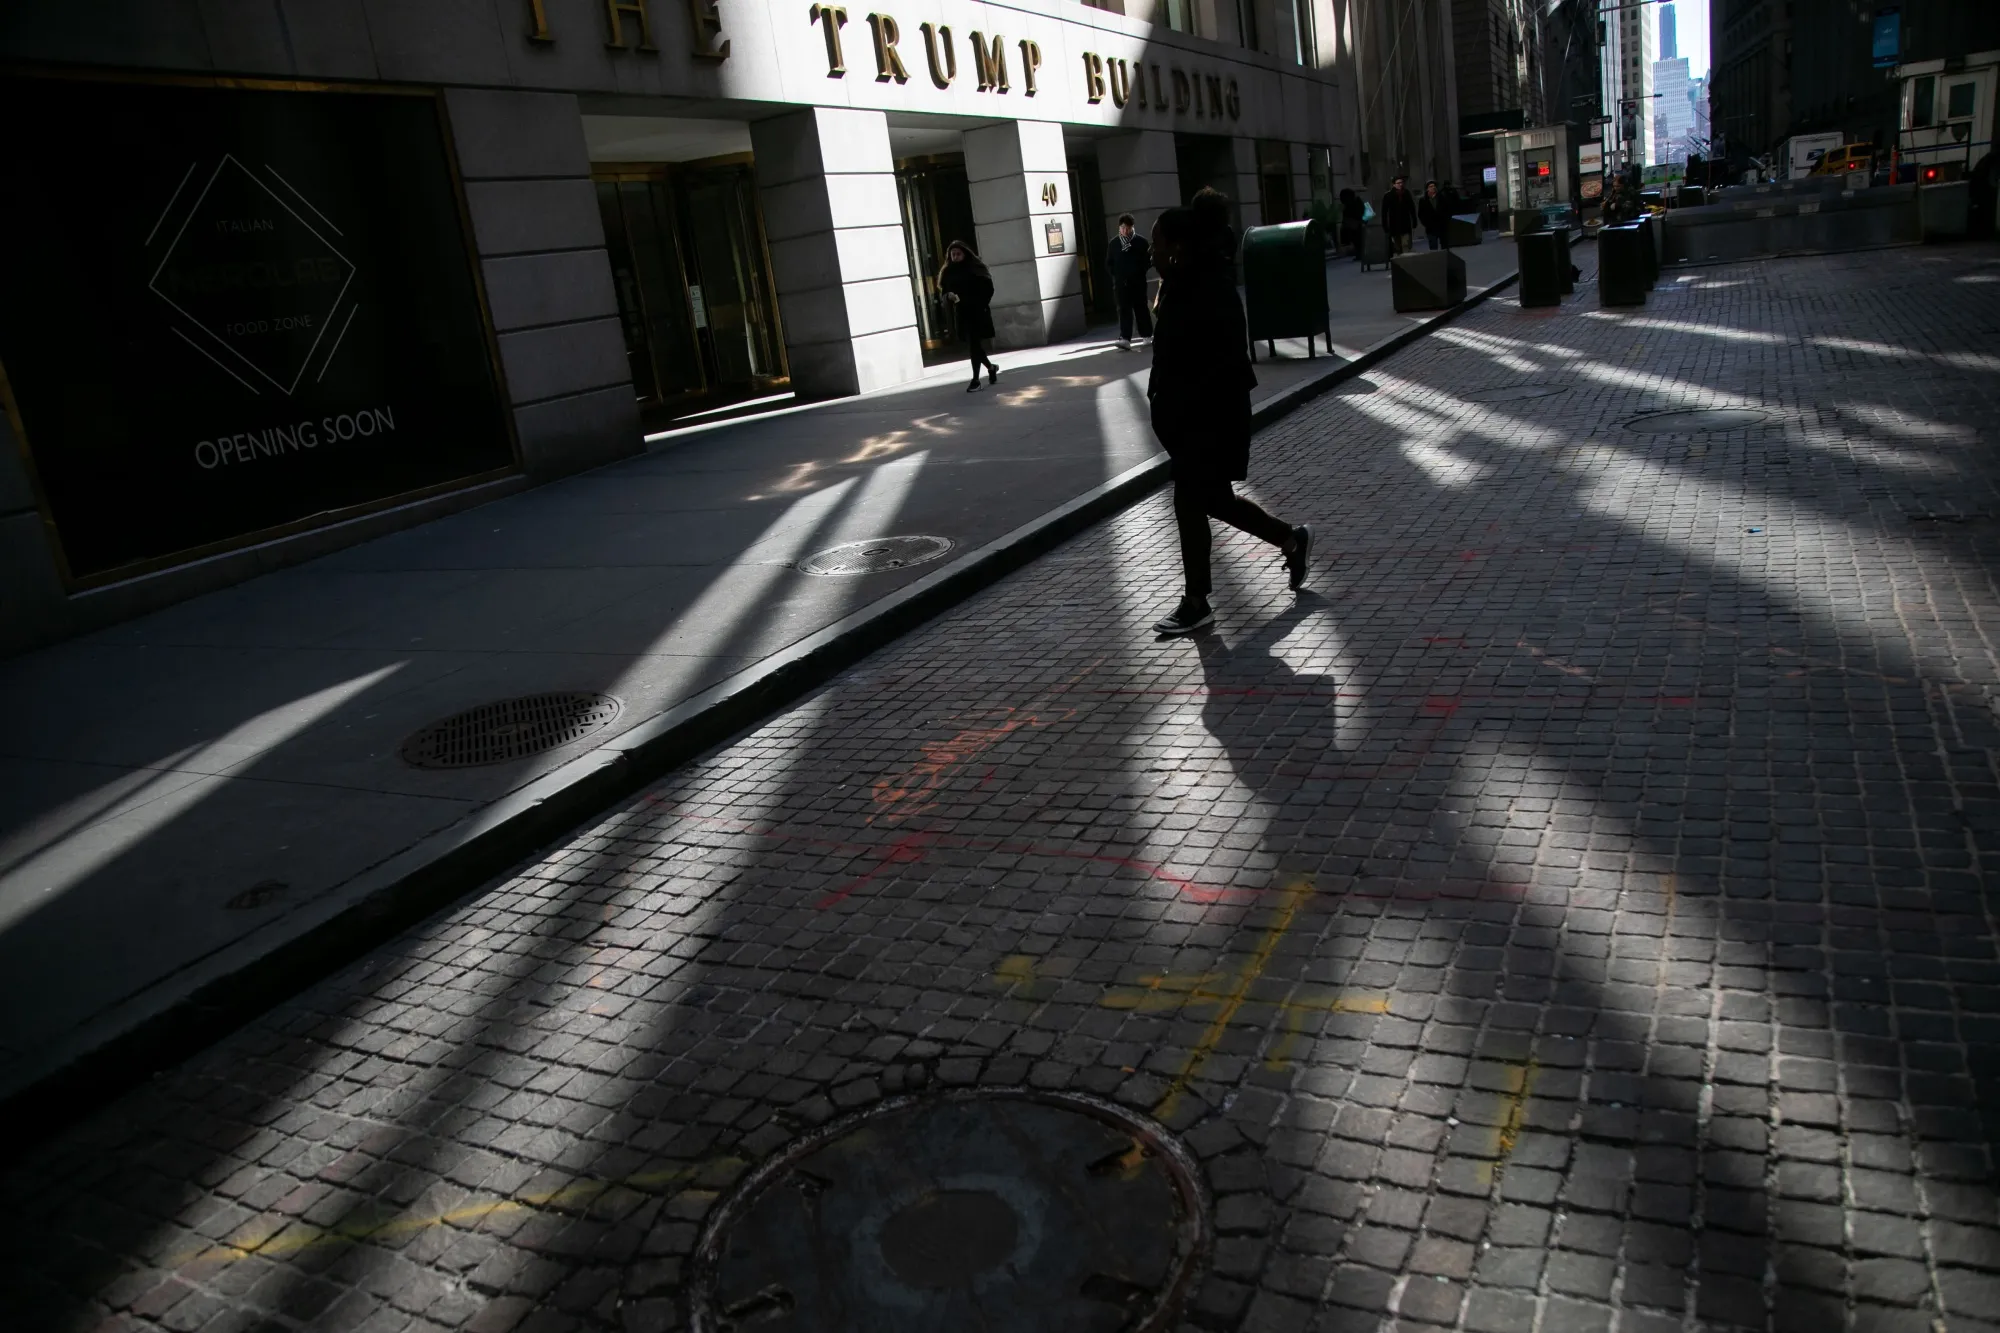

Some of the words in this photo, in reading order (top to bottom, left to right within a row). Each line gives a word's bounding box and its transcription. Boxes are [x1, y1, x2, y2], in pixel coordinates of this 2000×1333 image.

[809, 2, 1042, 98] TRUMP
[1082, 52, 1240, 121] BUILDING
[1041, 182, 1058, 207] 40
[215, 218, 274, 233] ITALIAN
[225, 319, 269, 337] FOOD
[273, 314, 314, 332] ZONE
[194, 420, 319, 470] OPENING
[322, 404, 396, 444] SOON
